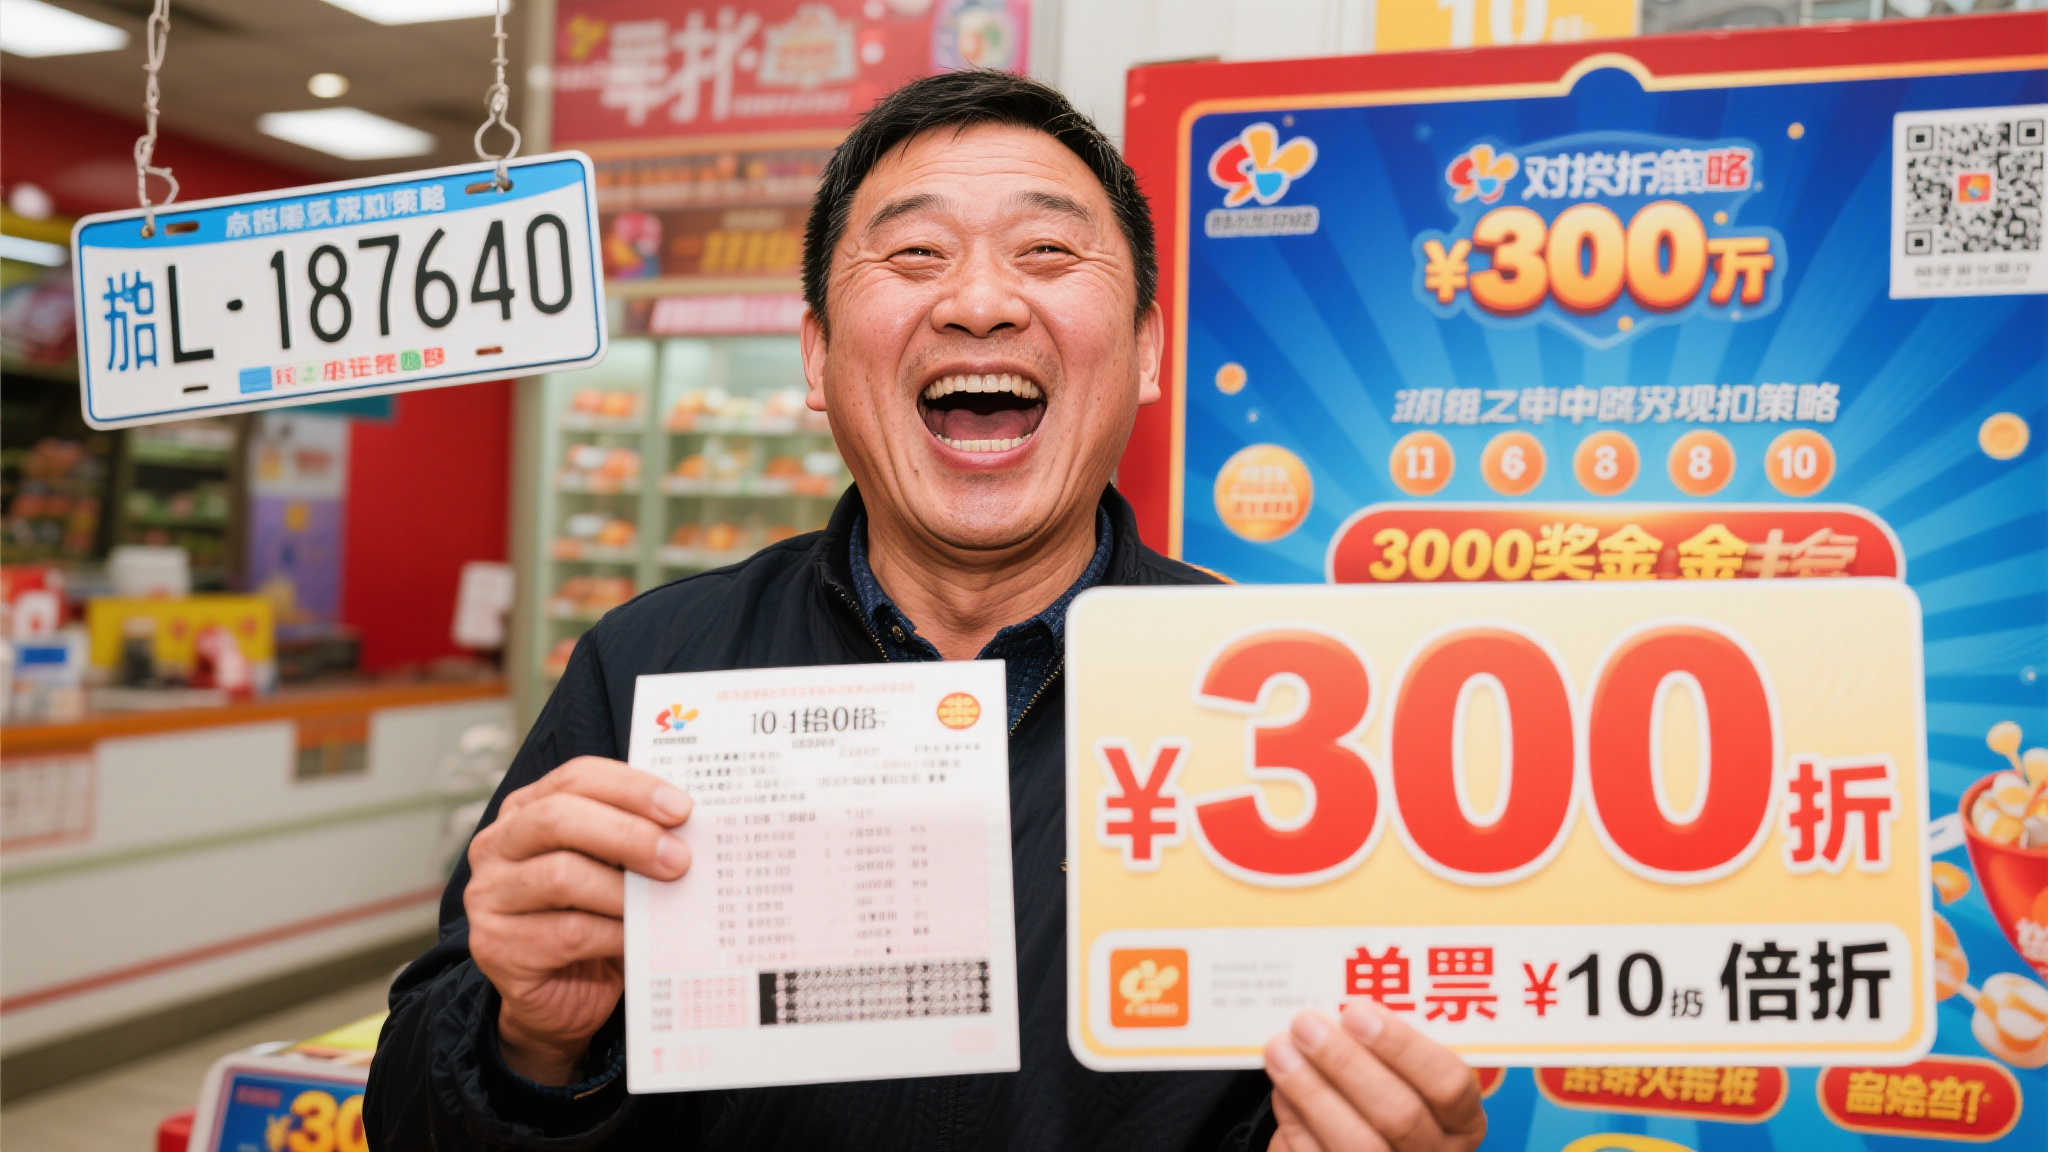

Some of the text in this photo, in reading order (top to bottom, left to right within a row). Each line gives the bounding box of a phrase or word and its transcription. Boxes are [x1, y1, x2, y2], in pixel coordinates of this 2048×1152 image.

[1500, 445, 1526, 479] 6
[1688, 445, 1713, 480] 8
[1777, 446, 1818, 480] 10
[1369, 523, 1663, 581] 3000奖金
[1103, 625, 1893, 876] ¥300折
[1340, 946, 1498, 1022] 单票
[1719, 940, 1891, 1022] 倍折
